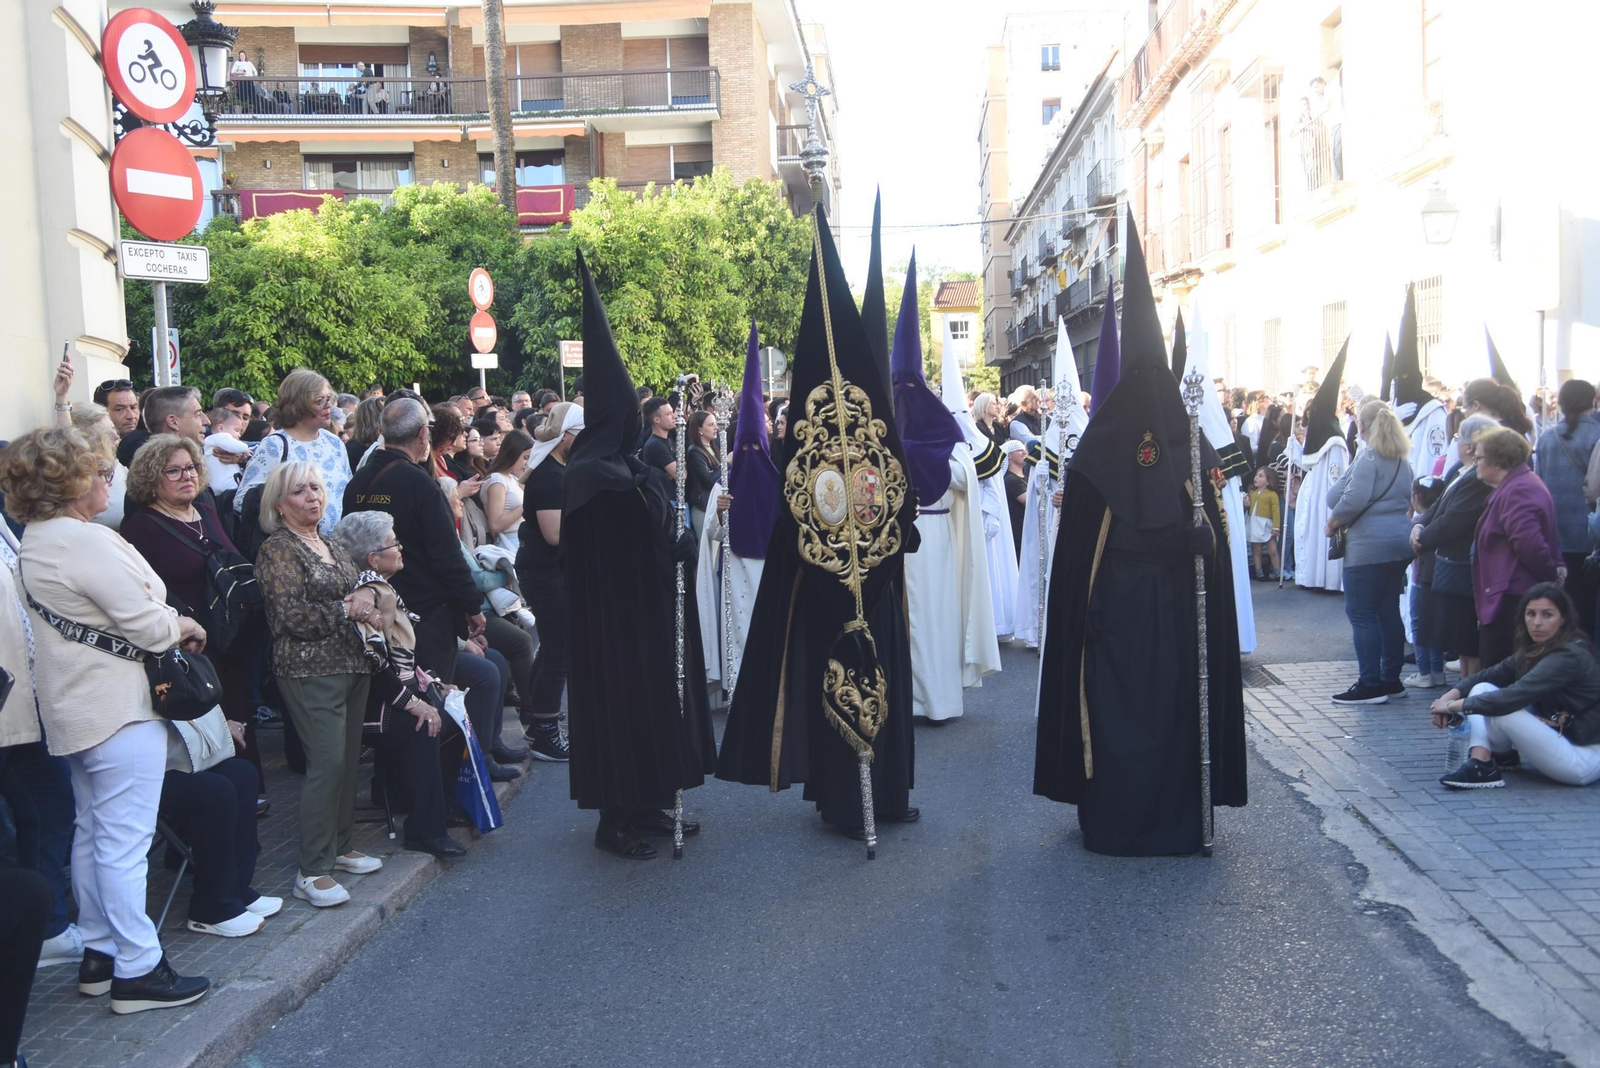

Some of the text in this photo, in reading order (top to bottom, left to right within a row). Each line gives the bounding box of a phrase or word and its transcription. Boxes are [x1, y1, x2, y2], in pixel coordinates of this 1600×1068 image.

[128, 247, 198, 262] EXCEPTO TAXIS
[145, 262, 188, 275] COCHERAS
